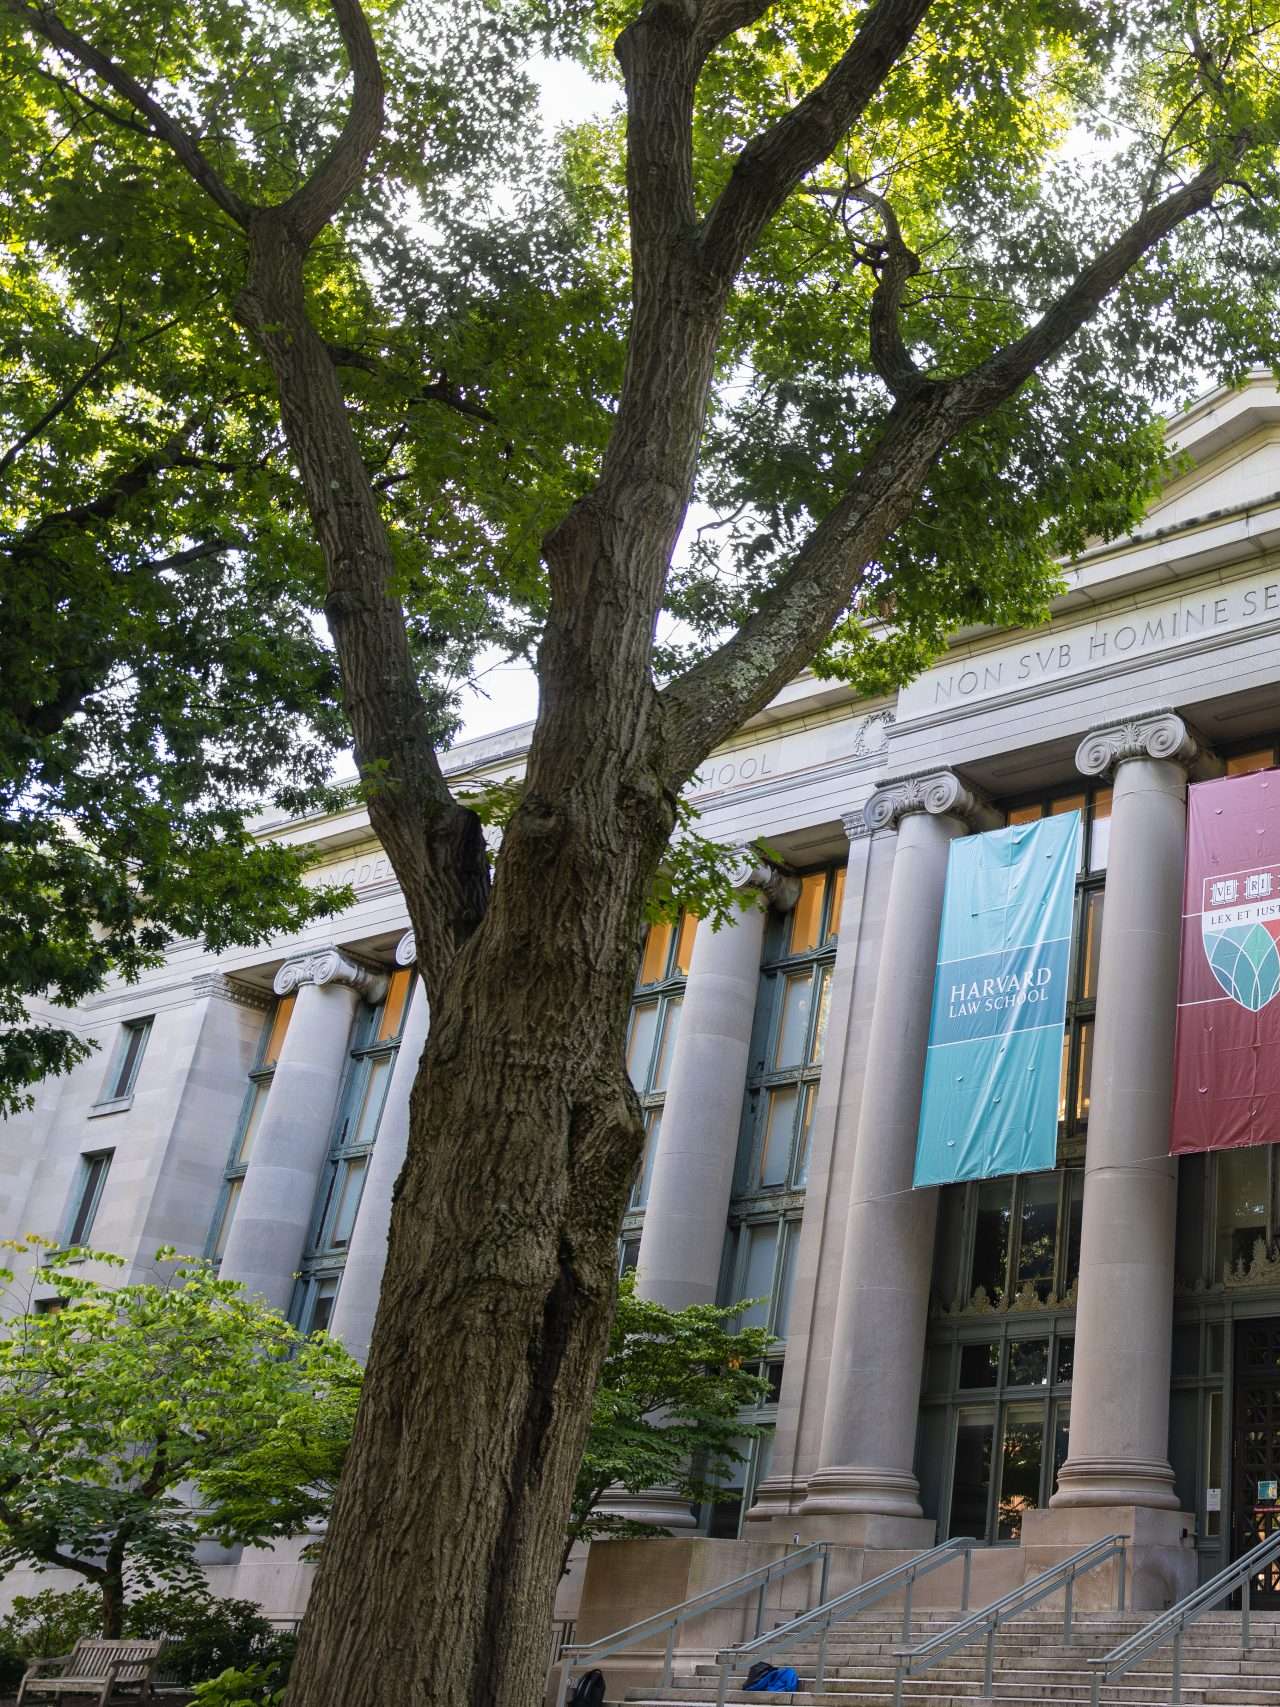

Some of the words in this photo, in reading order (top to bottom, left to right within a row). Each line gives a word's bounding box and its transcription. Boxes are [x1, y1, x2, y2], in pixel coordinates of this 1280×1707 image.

[935, 663, 1002, 704] NON
[1017, 644, 1072, 680] SVB
[1089, 598, 1229, 660] HOMINE
[1211, 913, 1232, 925] LEX
[1237, 910, 1250, 921] ET
[950, 967, 1052, 1003] HARVARD
[948, 1001, 981, 1018] LAW
[984, 988, 1049, 1012] SCHOOL
